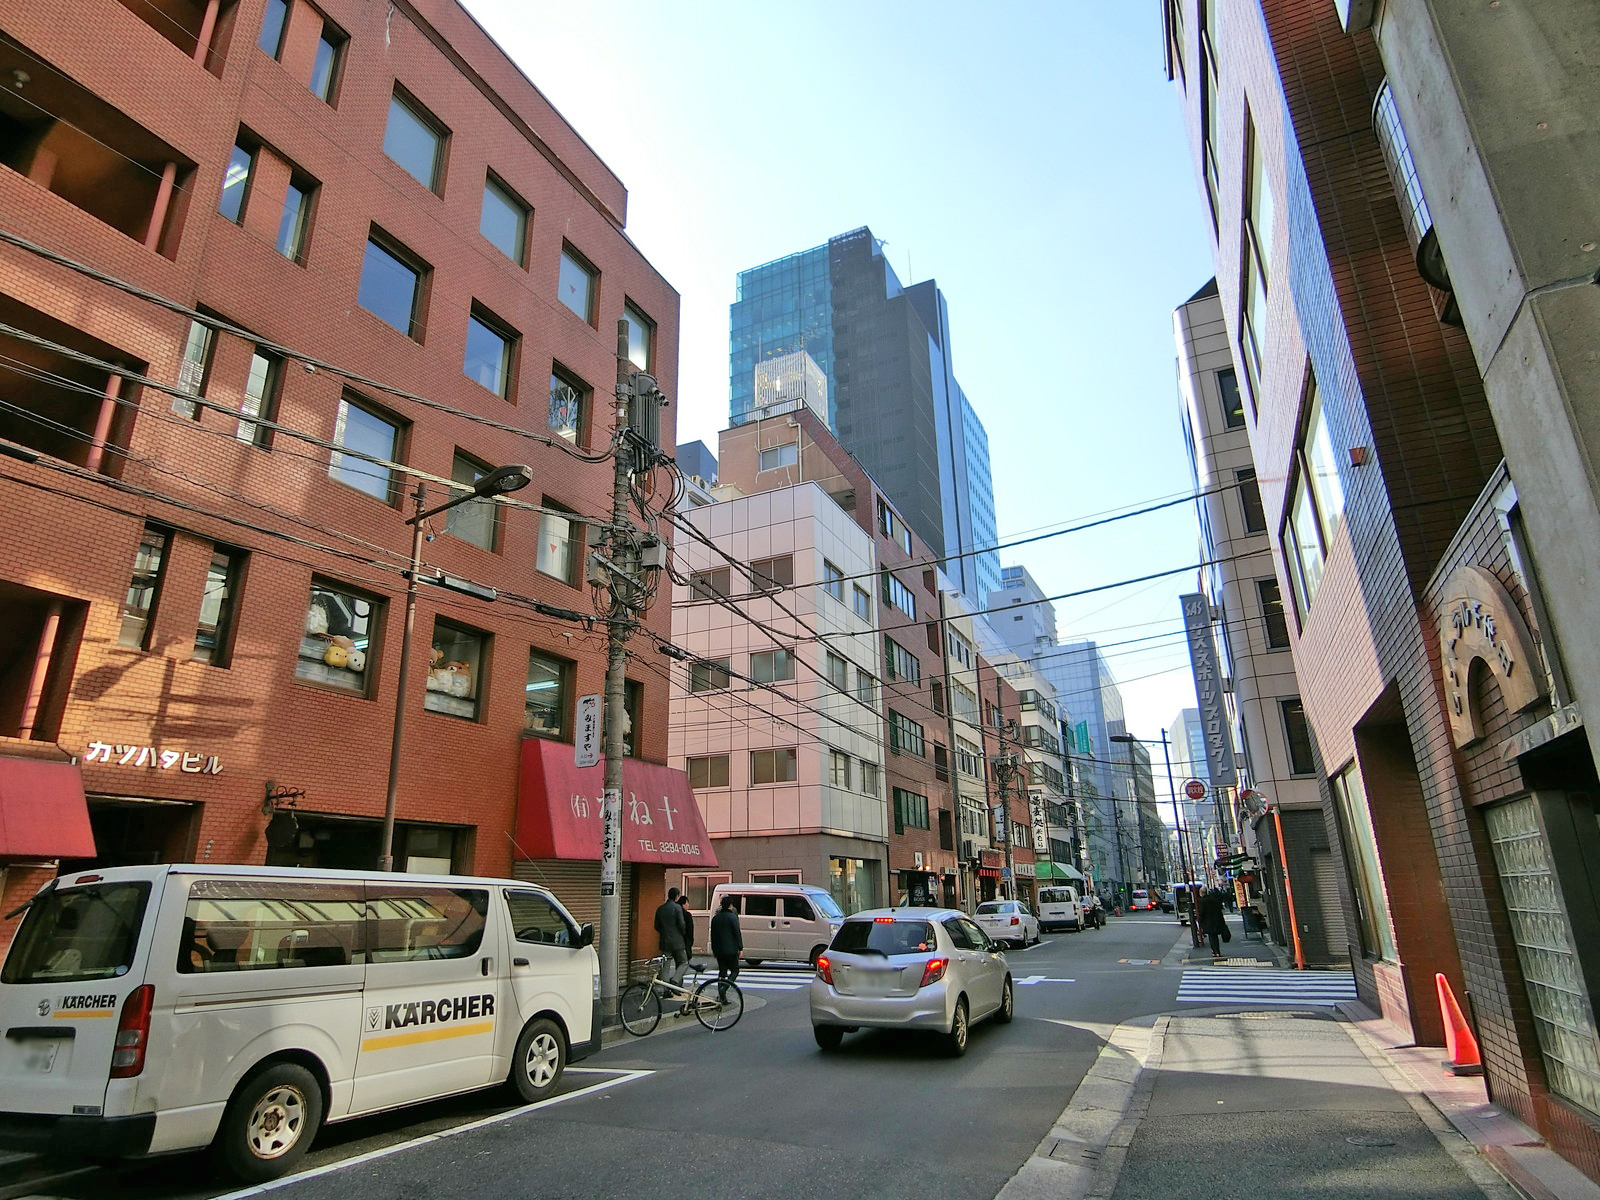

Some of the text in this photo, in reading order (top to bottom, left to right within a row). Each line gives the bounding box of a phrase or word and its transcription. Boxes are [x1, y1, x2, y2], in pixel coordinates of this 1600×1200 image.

[85, 740, 224, 775] カツハタビル
[638, 839, 700, 855] TEL 3294-0045
[62, 994, 117, 1009] KÄRCHER
[384, 993, 495, 1030] KÄRCHER
